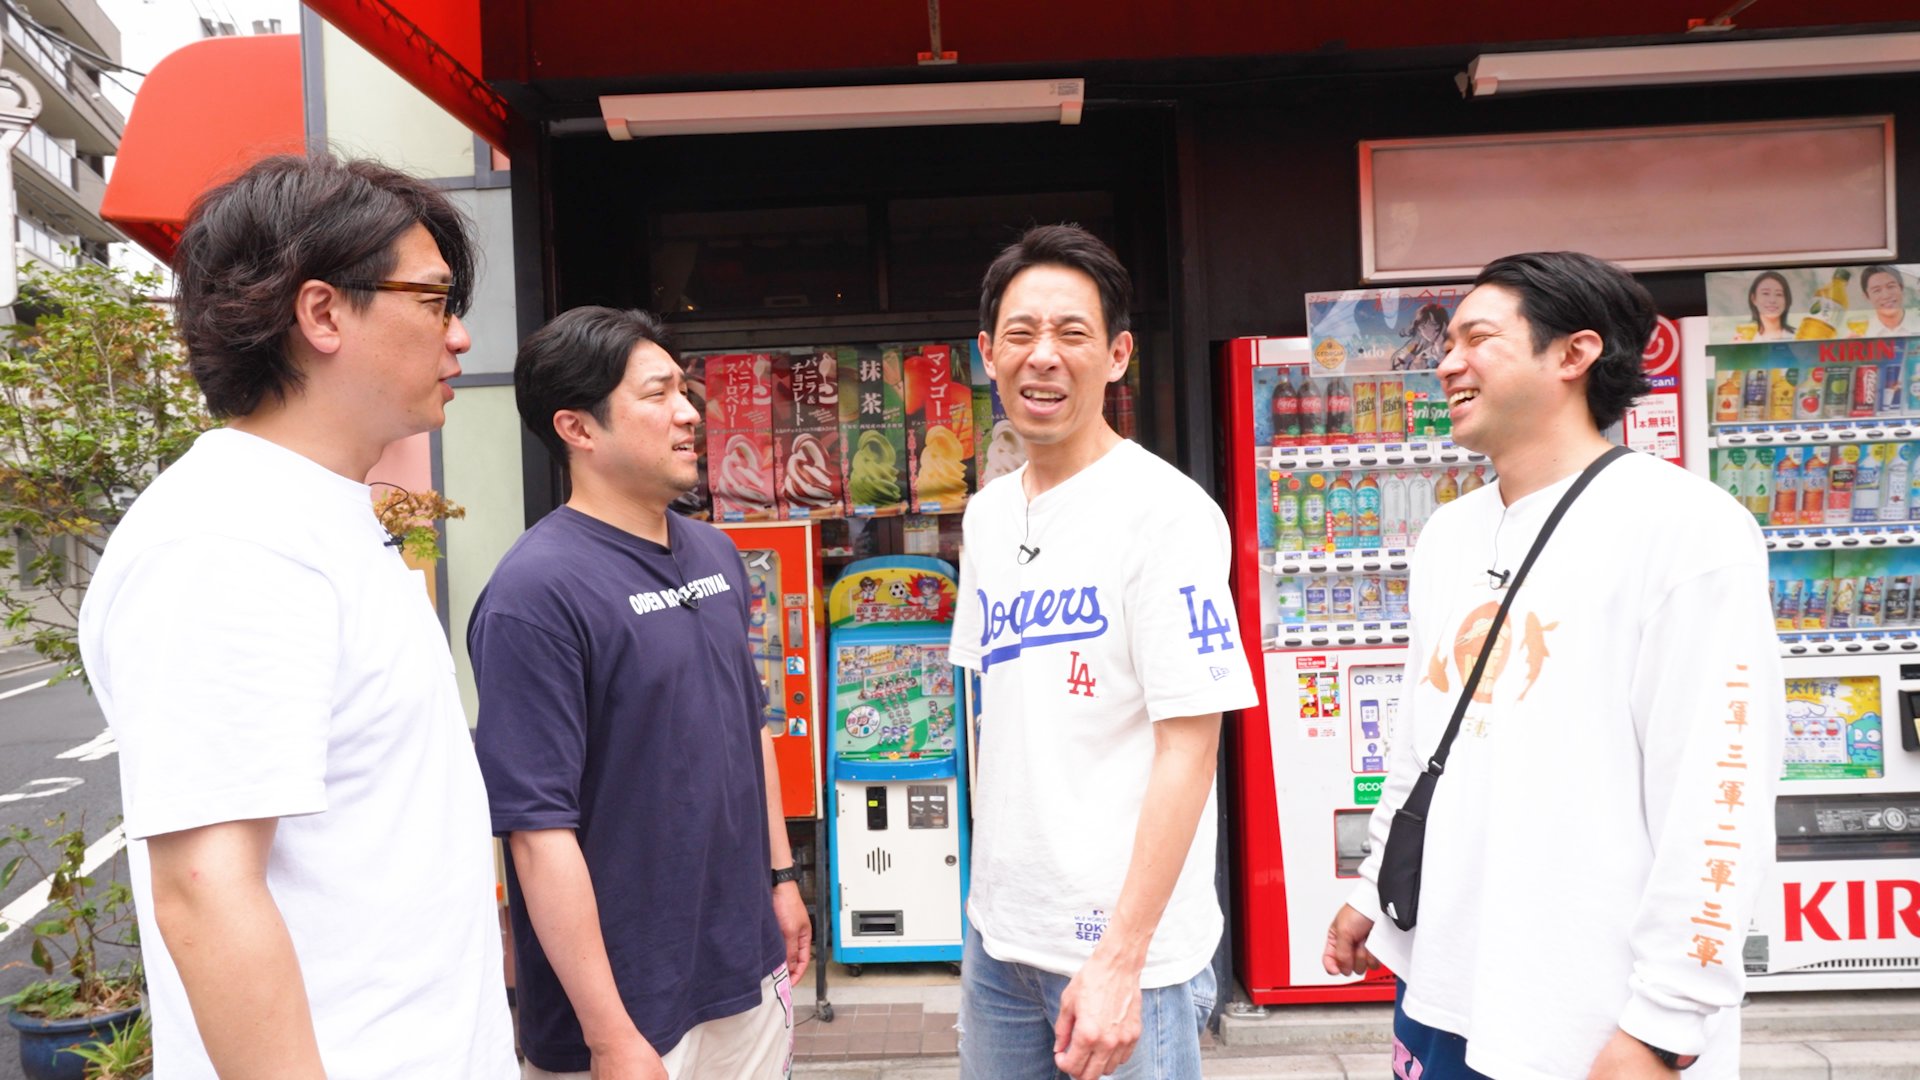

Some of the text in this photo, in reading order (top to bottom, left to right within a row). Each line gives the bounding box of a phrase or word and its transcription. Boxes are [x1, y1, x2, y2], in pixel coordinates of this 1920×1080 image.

[1818, 340, 1896, 362] KIRIN
[725, 363, 739, 428] ストロベリー
[792, 363, 805, 426] チョコレート
[859, 360, 882, 415] 抹茶
[927, 352, 949, 417] マンゴー
[1178, 585, 1235, 655] LA
[1067, 651, 1096, 697] LA
[1783, 879, 1920, 942] KIR
